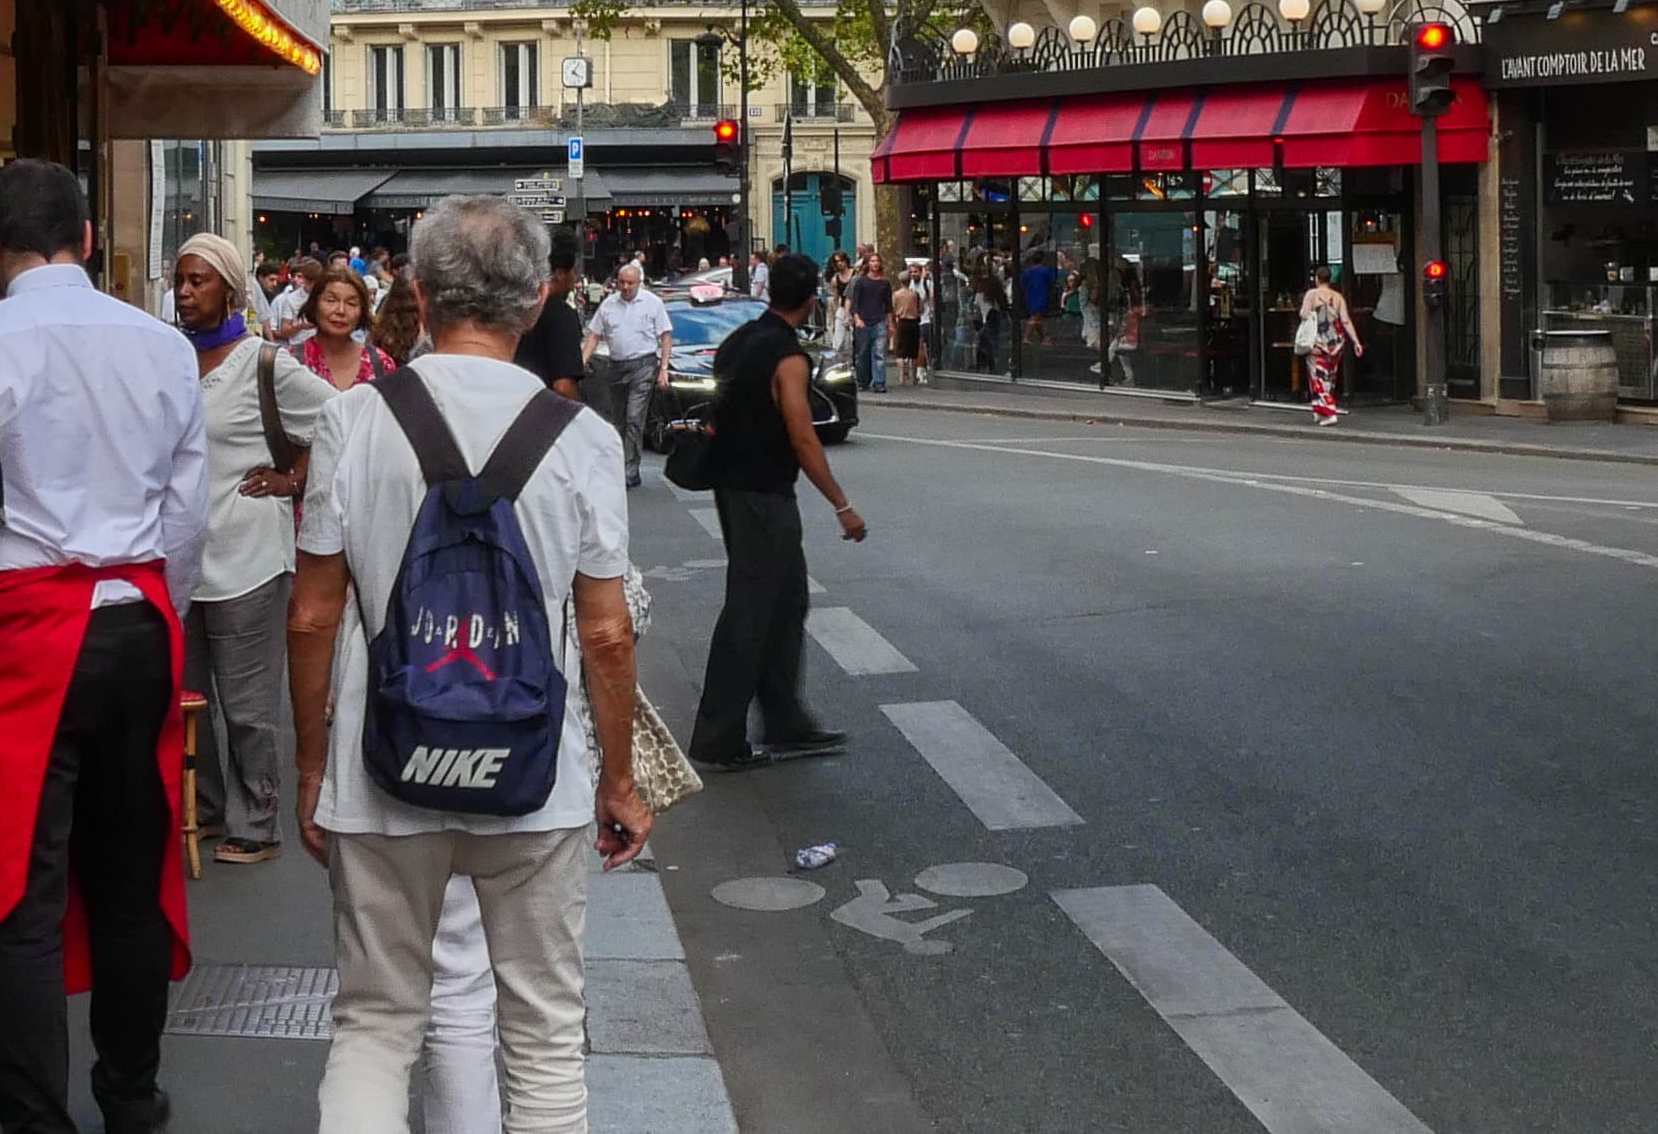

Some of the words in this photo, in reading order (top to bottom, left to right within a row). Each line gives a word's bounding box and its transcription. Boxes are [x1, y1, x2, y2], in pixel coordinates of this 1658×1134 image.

[1502, 56, 1537, 79] L'AVANT
[1537, 51, 1588, 77] COMPTOIR
[1590, 50, 1604, 73] DE
[1605, 49, 1619, 72] LA
[1621, 47, 1646, 70] MER
[401, 745, 511, 788] NIKE
